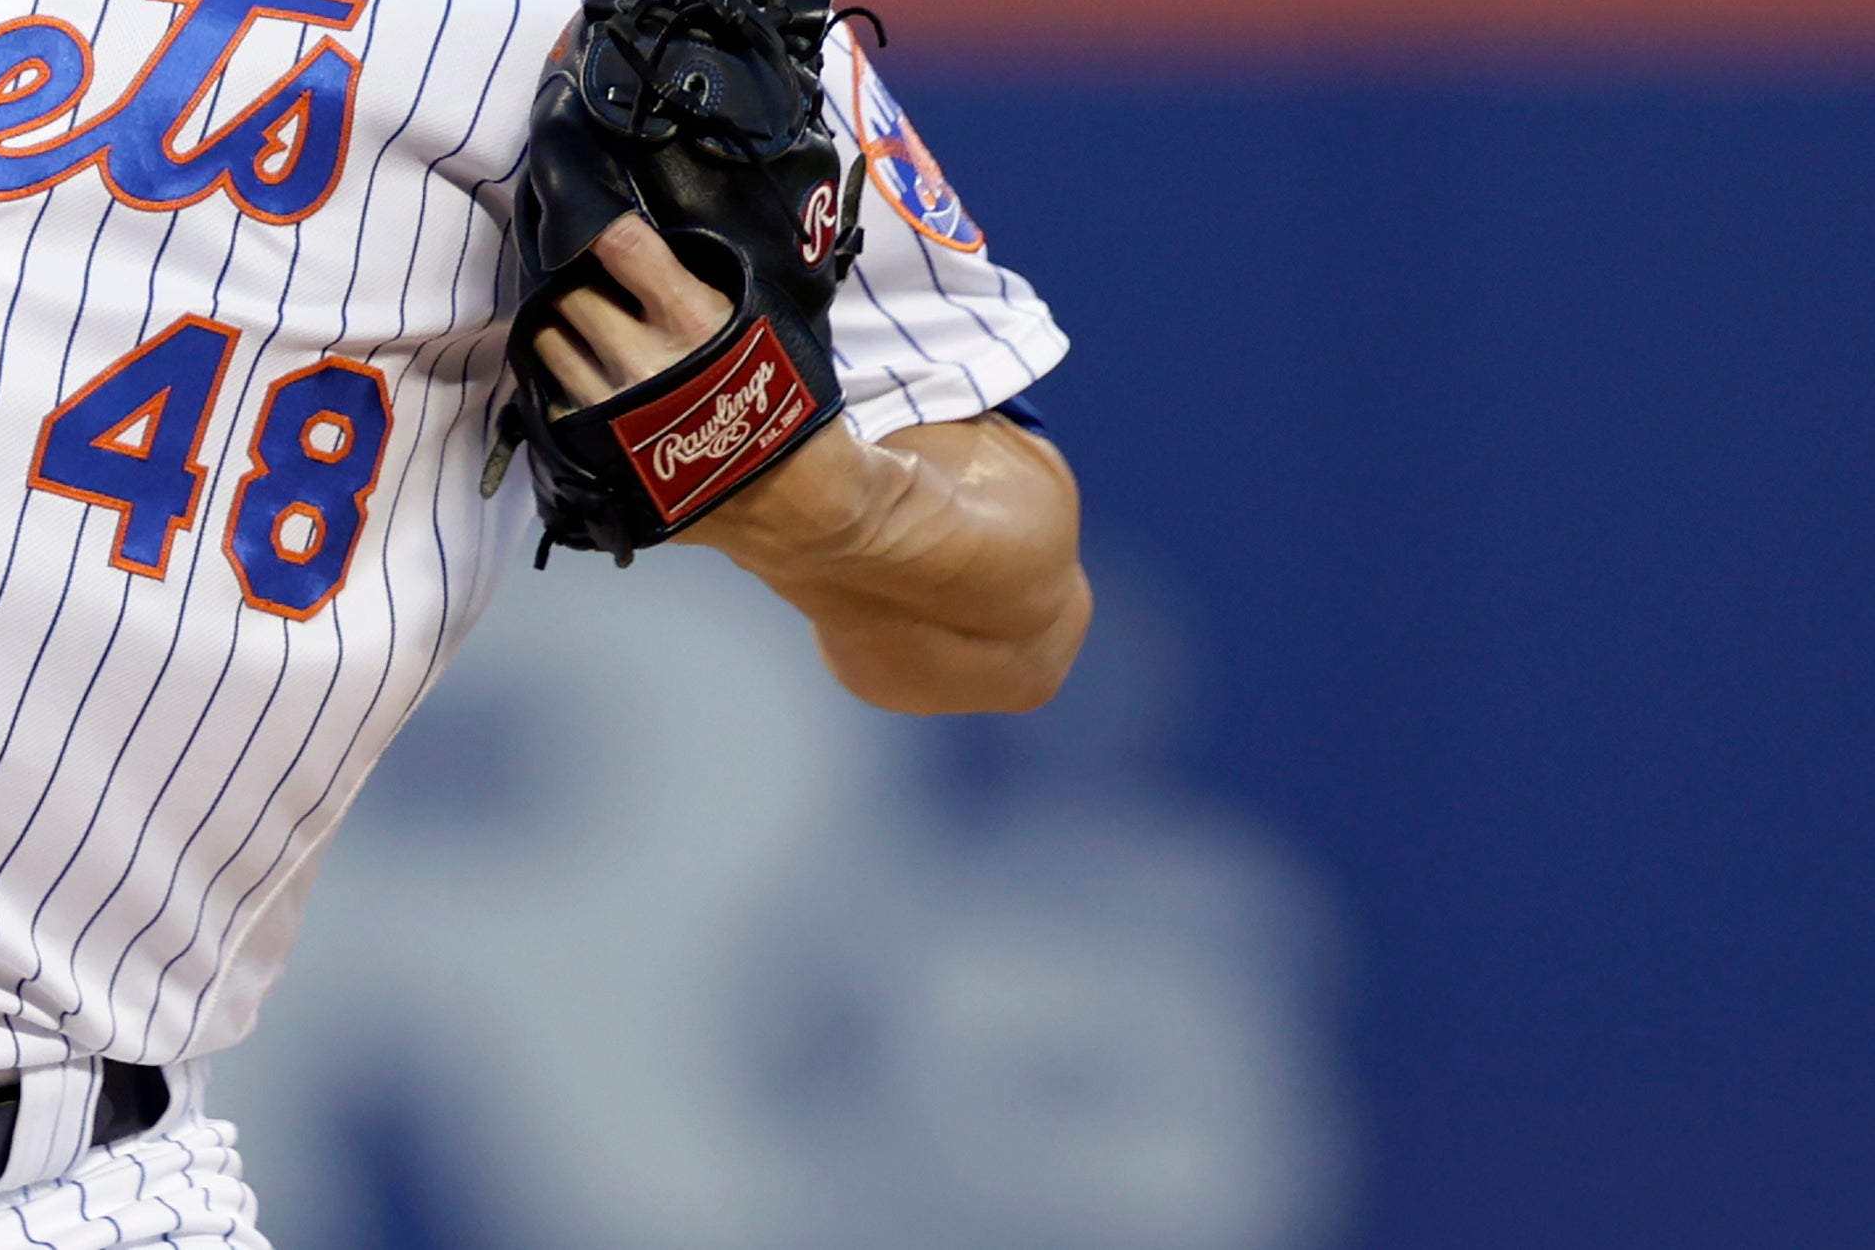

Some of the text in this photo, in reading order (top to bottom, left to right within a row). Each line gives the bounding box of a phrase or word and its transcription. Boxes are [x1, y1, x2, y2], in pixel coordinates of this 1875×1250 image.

[802, 185, 836, 263] R
[28, 312, 394, 622] 48
[653, 361, 775, 480] Rawlings
